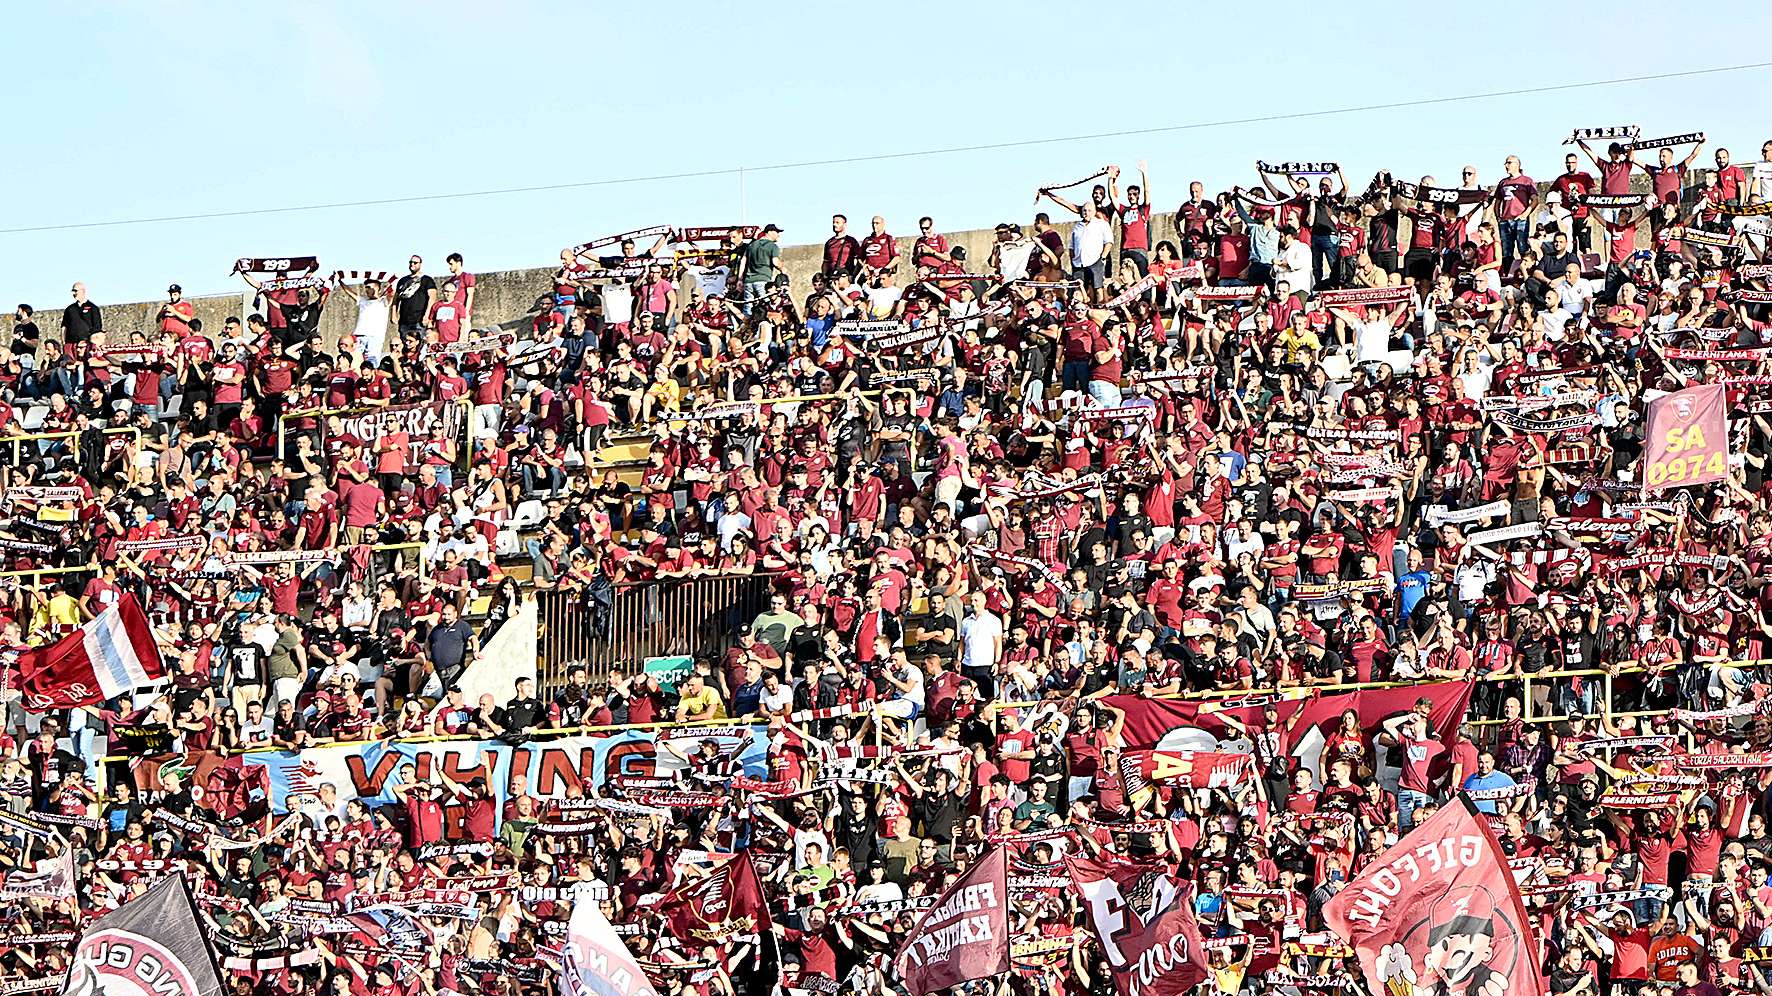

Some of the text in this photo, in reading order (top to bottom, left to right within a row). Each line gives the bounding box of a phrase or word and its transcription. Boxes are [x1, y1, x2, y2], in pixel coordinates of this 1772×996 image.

[1428, 189, 1457, 202] 1919
[1664, 425, 1706, 453] SA
[1647, 453, 1727, 485] 0974
[1567, 519, 1632, 531] Salerno
